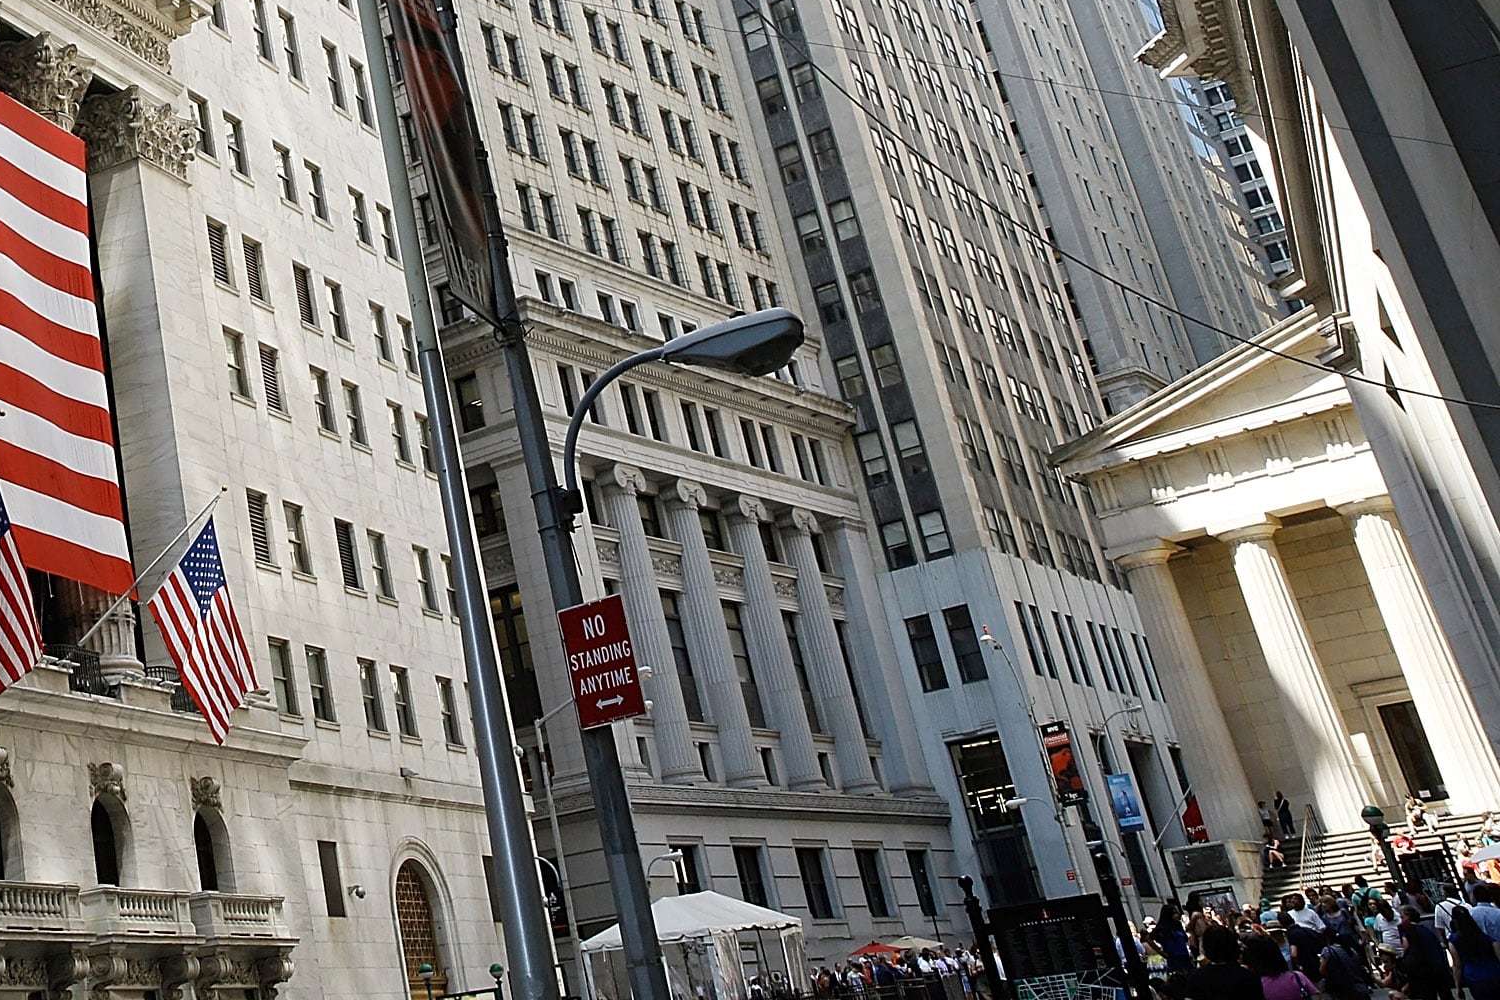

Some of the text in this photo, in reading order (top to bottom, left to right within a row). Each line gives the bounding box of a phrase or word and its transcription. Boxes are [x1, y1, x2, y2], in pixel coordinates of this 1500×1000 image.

[582, 614, 605, 639] NO
[570, 640, 631, 671] STANDING
[580, 666, 633, 695] ANYTIME
